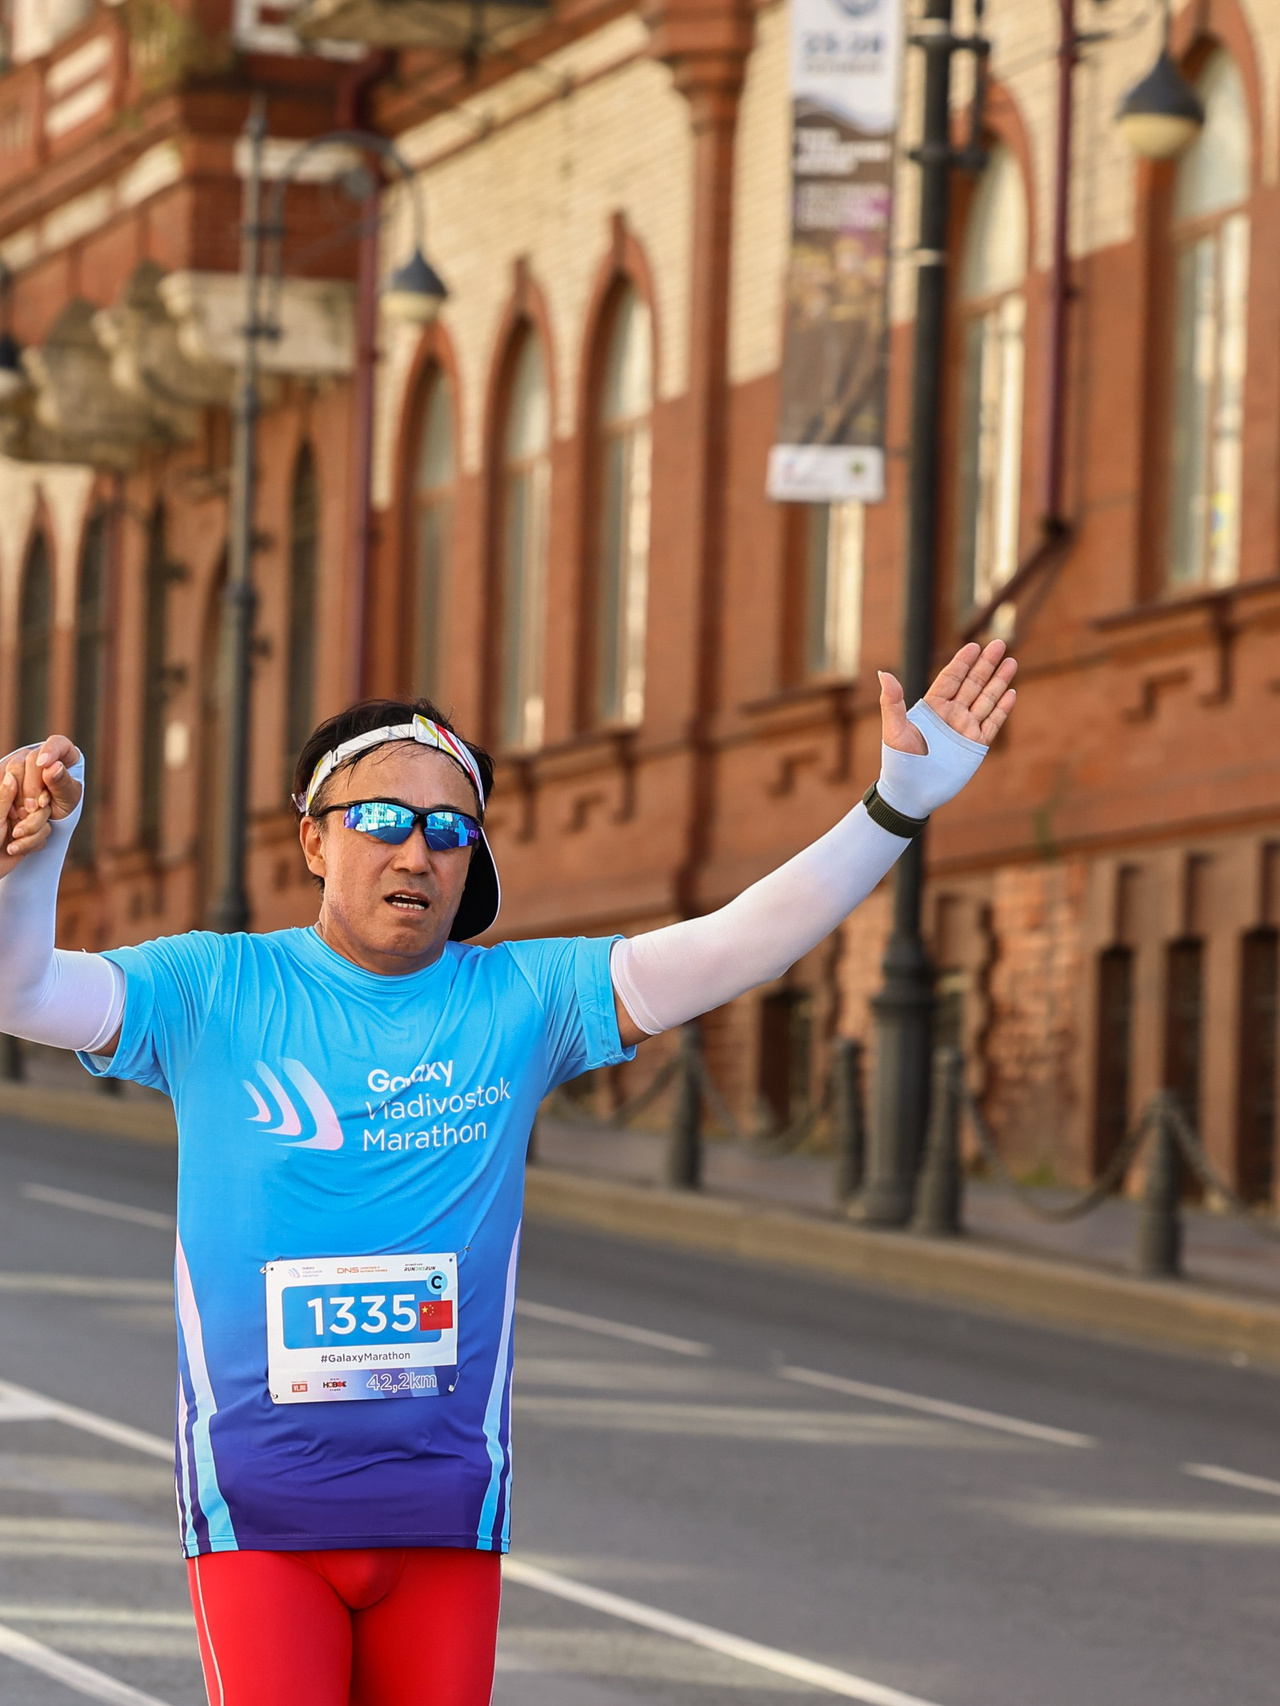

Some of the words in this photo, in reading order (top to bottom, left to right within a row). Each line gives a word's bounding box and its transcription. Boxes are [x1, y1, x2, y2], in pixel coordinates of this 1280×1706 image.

[365, 1077, 511, 1120] Vladivostok
[363, 1121, 487, 1151] Marathon
[431, 1275, 442, 1289] C
[307, 1294, 417, 1335] 1335
[321, 1351, 410, 1363] #GalaxyMarathon
[366, 1372, 438, 1393] 42,2km
